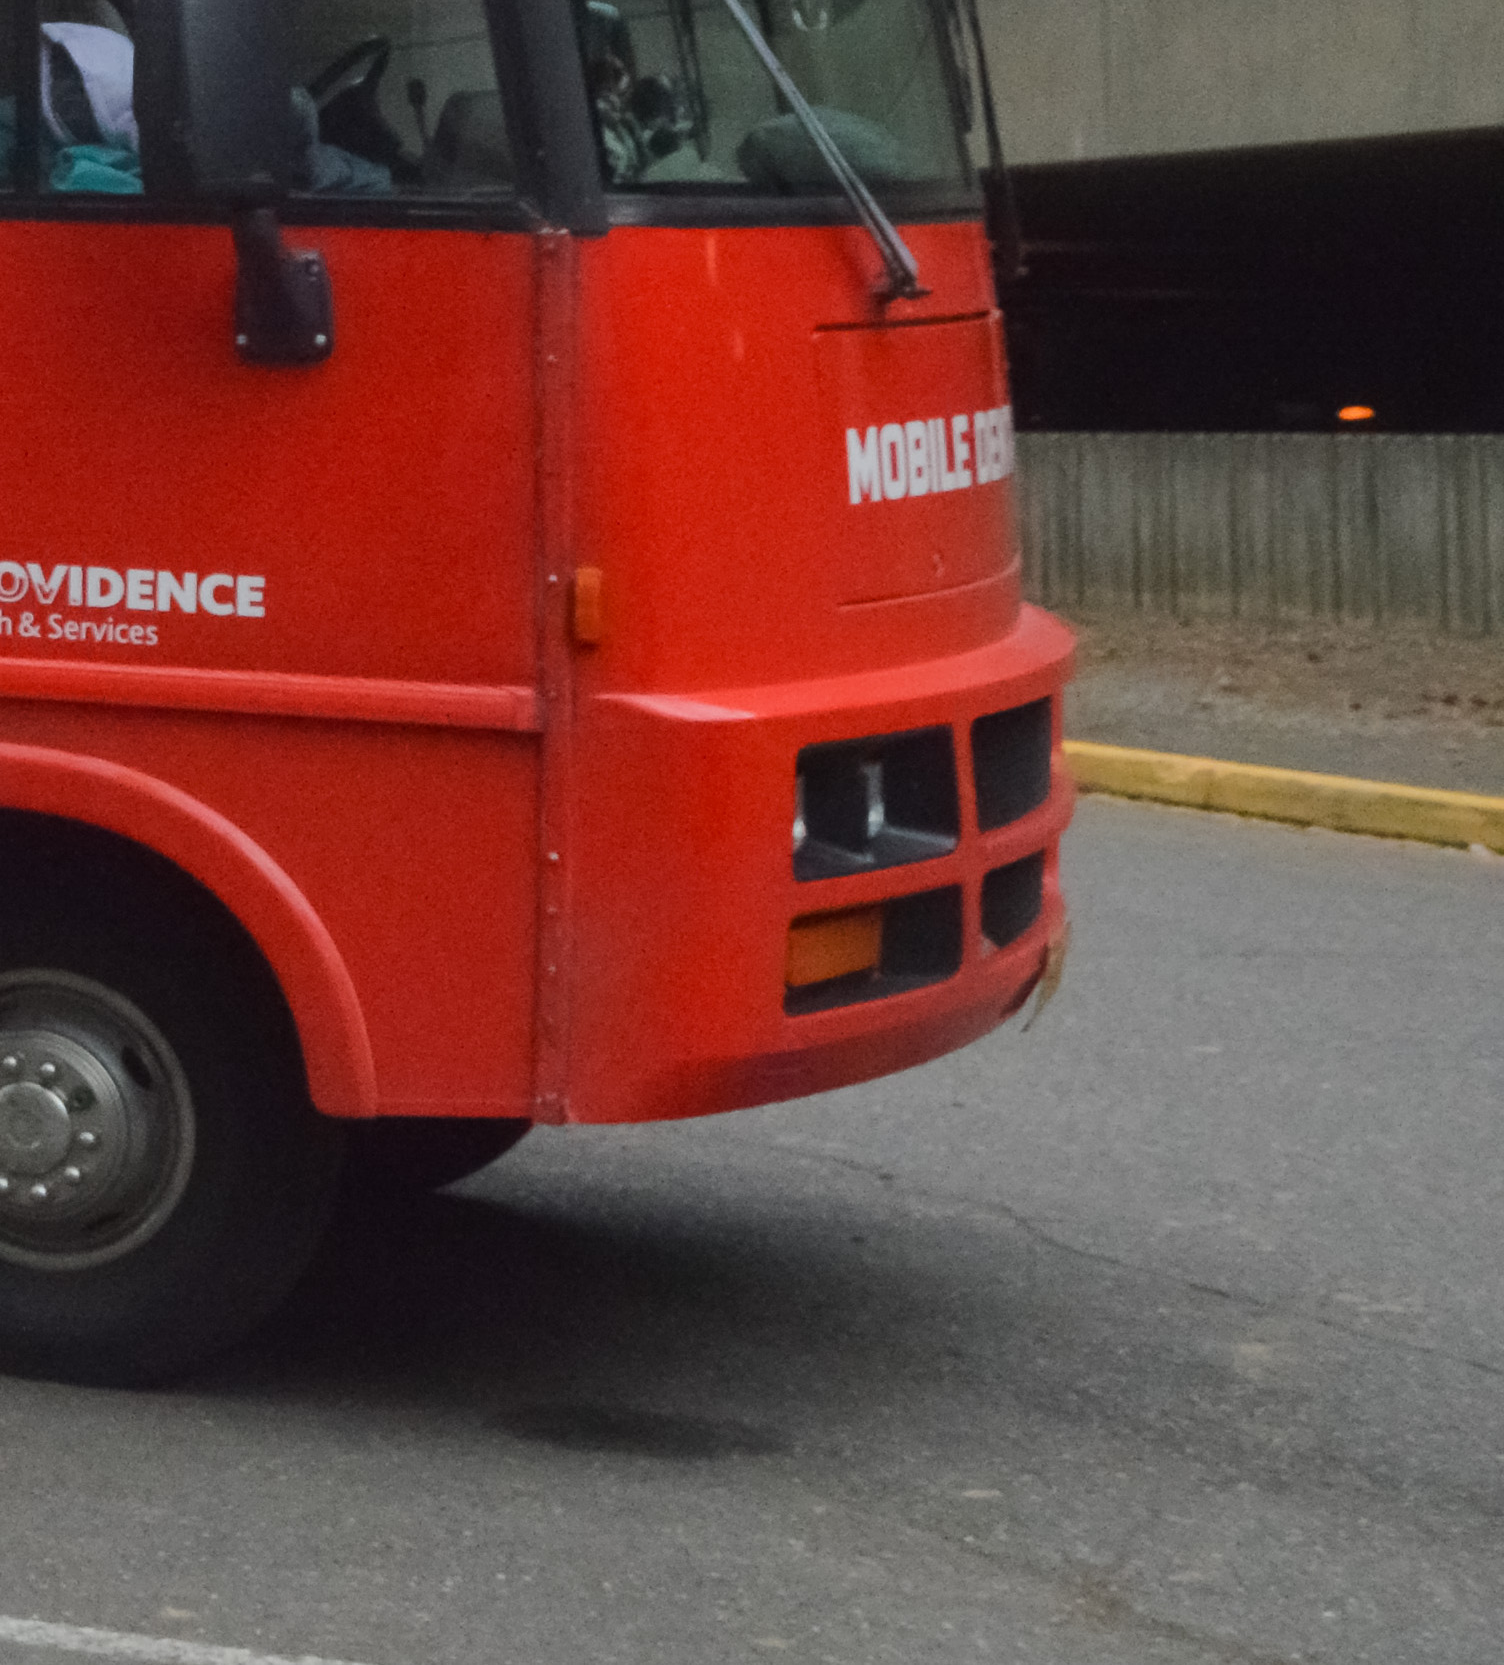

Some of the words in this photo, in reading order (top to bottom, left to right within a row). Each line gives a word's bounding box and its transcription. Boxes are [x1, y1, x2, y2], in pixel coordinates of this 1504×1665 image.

[846, 414, 972, 505] MOBILE
[18, 612, 42, 638] &
[47, 614, 159, 646] Services
